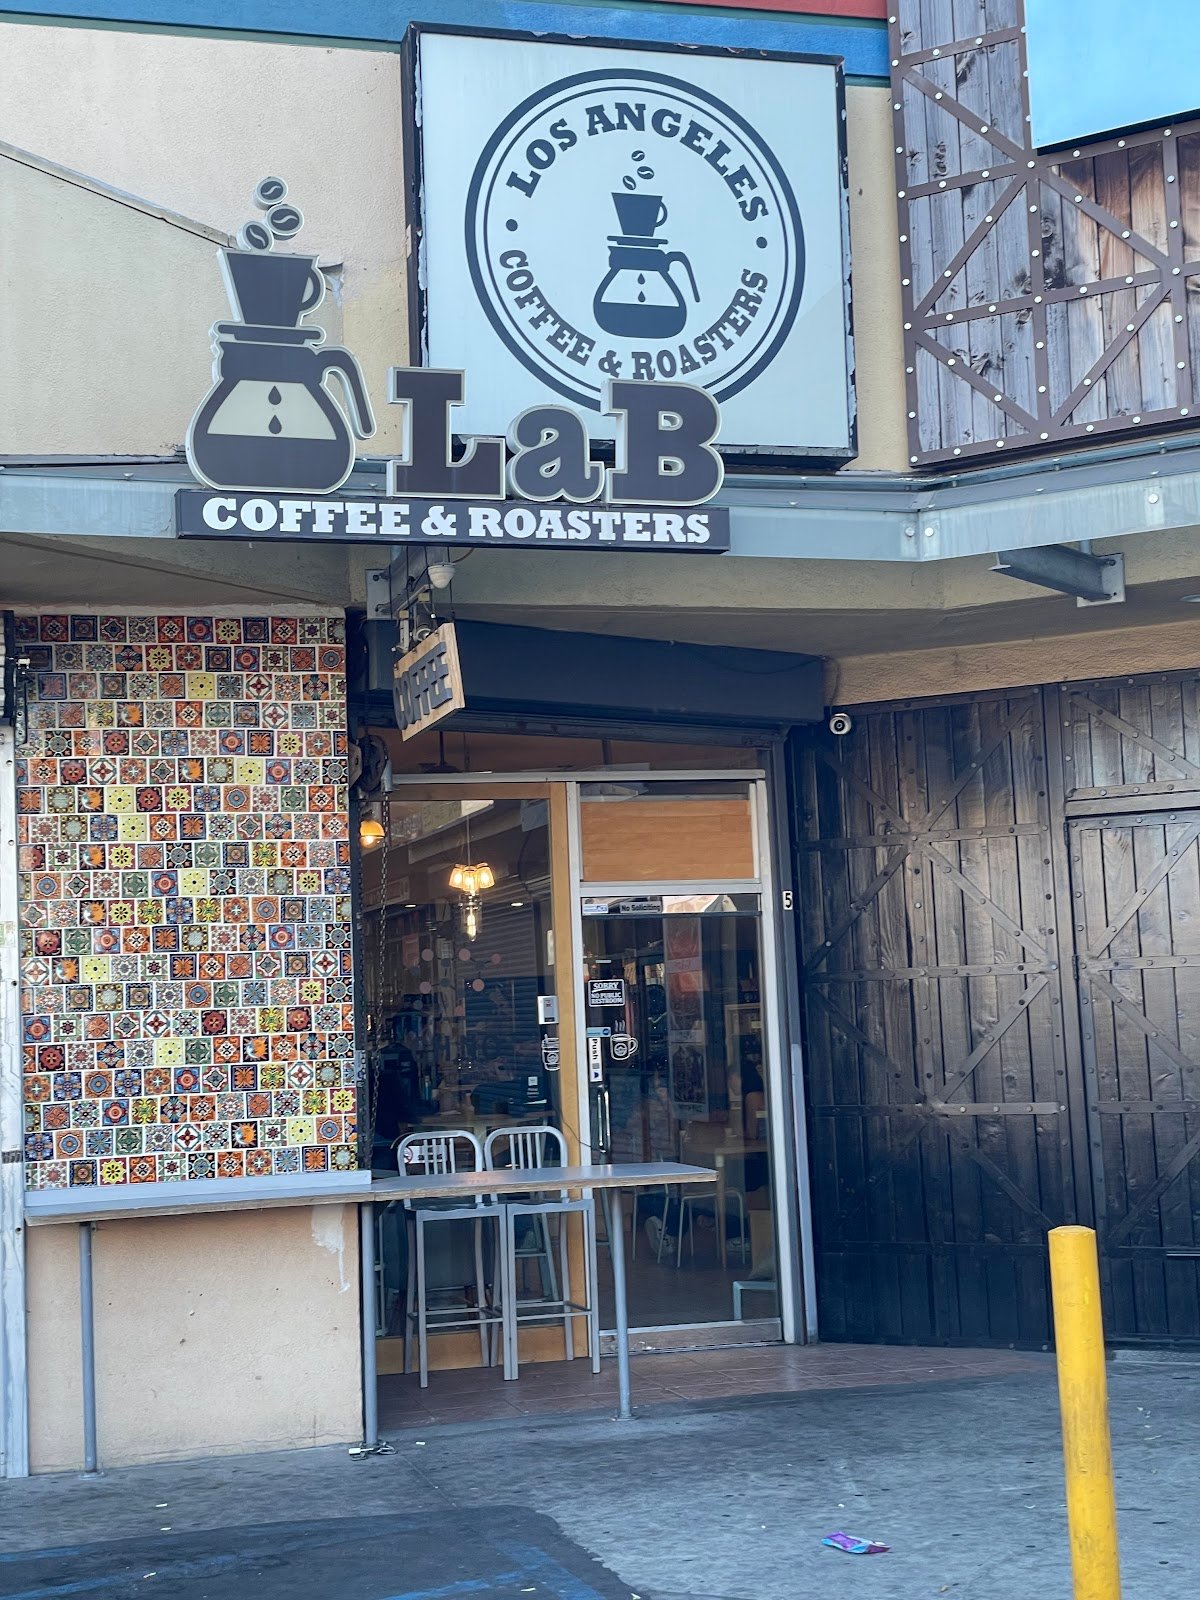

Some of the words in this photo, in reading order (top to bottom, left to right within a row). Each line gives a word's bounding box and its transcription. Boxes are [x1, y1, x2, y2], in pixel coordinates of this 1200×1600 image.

[506, 118, 577, 198] LOS
[585, 102, 769, 221] ANGELES
[500, 250, 596, 366] COFFEE
[598, 350, 622, 378] &
[631, 268, 768, 380] ROASTERS
[387, 367, 724, 506] LaB
[202, 496, 411, 537] COFFEE
[421, 505, 456, 536] &
[468, 507, 711, 543] ROASTERS
[621, 904, 630, 912] No
[631, 903, 660, 912] Soliciting
[785, 892, 792, 908] 5
[593, 982, 619, 990] SORRY
